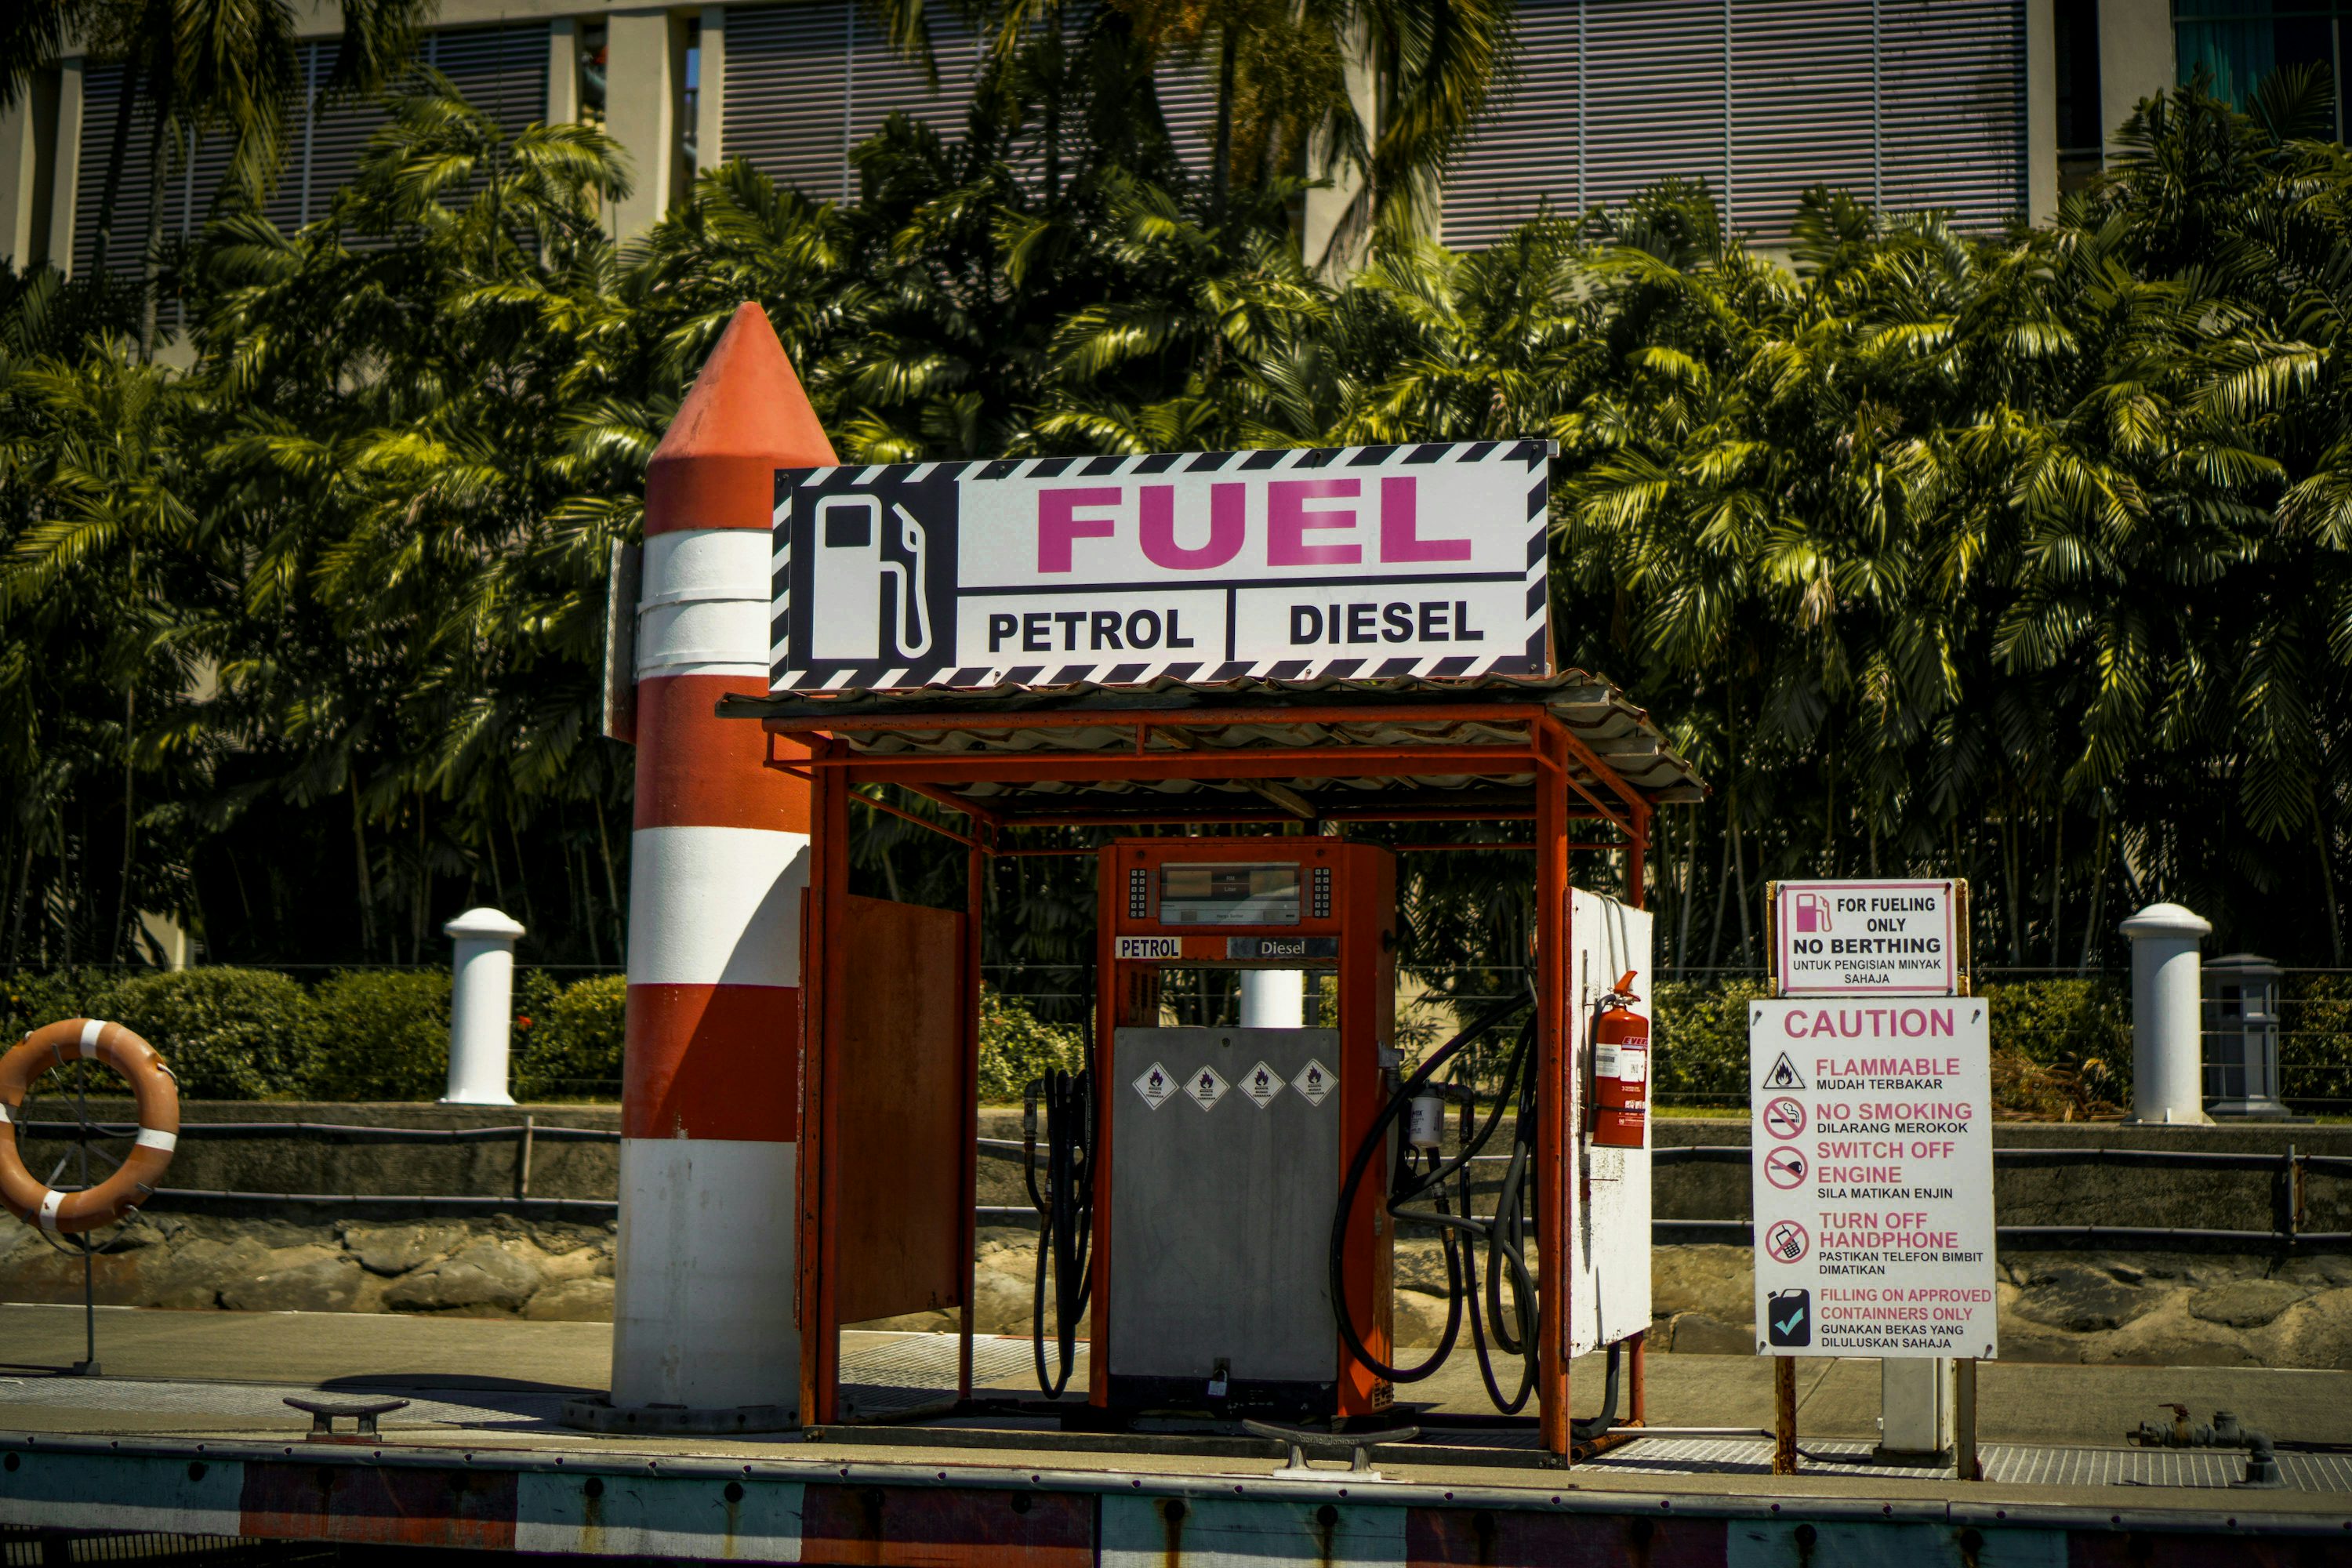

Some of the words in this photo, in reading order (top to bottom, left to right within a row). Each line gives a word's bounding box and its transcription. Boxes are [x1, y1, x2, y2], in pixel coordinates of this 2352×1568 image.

[1037, 477, 1472, 573] FUEL
[1289, 600, 1485, 646] DIESEL
[989, 608, 1194, 653] PETROL
[1838, 898, 1866, 912] FOR
[1871, 898, 1935, 911] FUELING
[1867, 919, 1906, 931] ONLY
[1122, 939, 1179, 957] PETROL
[1261, 942, 1305, 955] Diesel
[1794, 939, 1823, 954] NO
[1831, 938, 1940, 953] BERTHING
[1794, 960, 1831, 970] UNTUK
[1835, 960, 1895, 970] PENGISIAN
[1899, 960, 1941, 969] MINYAK
[1844, 974, 1889, 983] SAHAJA
[1784, 1009, 1954, 1038] CAUTION
[1816, 1058, 1960, 1076] FLAMMABLE
[1817, 1080, 1865, 1090] MUDAH
[1869, 1080, 1943, 1089] TERBAKAR
[1817, 1104, 1850, 1120] NO
[1858, 1103, 1972, 1120] SMOKING
[1817, 1123, 1890, 1134] DILARANG
[1895, 1123, 1968, 1133] MEROKOK
[1817, 1142, 1904, 1159] SWITCH
[1911, 1142, 1954, 1159] OFF
[1818, 1167, 1902, 1183] ENGINE
[1818, 1189, 1847, 1199] SILA
[1851, 1189, 1910, 1199] MATIKAN
[1915, 1189, 1953, 1199] ENJIN
[1820, 1213, 1877, 1229] TURN
[1886, 1213, 1927, 1229] OFF
[1820, 1232, 1958, 1248] HANDPHONE
[1820, 1252, 1879, 1261] PASTIKAN
[1882, 1252, 1938, 1261] TELEFON
[1943, 1253, 1984, 1261] BIMBIT
[1820, 1265, 1885, 1275] DIMATIKAN
[1820, 1289, 1877, 1301] FILLING
[1882, 1289, 1904, 1301] ON
[1908, 1290, 1991, 1302] APPROVED
[1821, 1307, 1928, 1320] CONTAINNERS
[1933, 1308, 1973, 1320] ONLY
[1821, 1324, 1882, 1334] GUNAKAN
[1886, 1325, 1926, 1334] BEKAS
[1930, 1326, 1963, 1334] YANG
[1822, 1338, 1898, 1348] DILULUSKAN
[1903, 1338, 1951, 1348] SAHAJA
